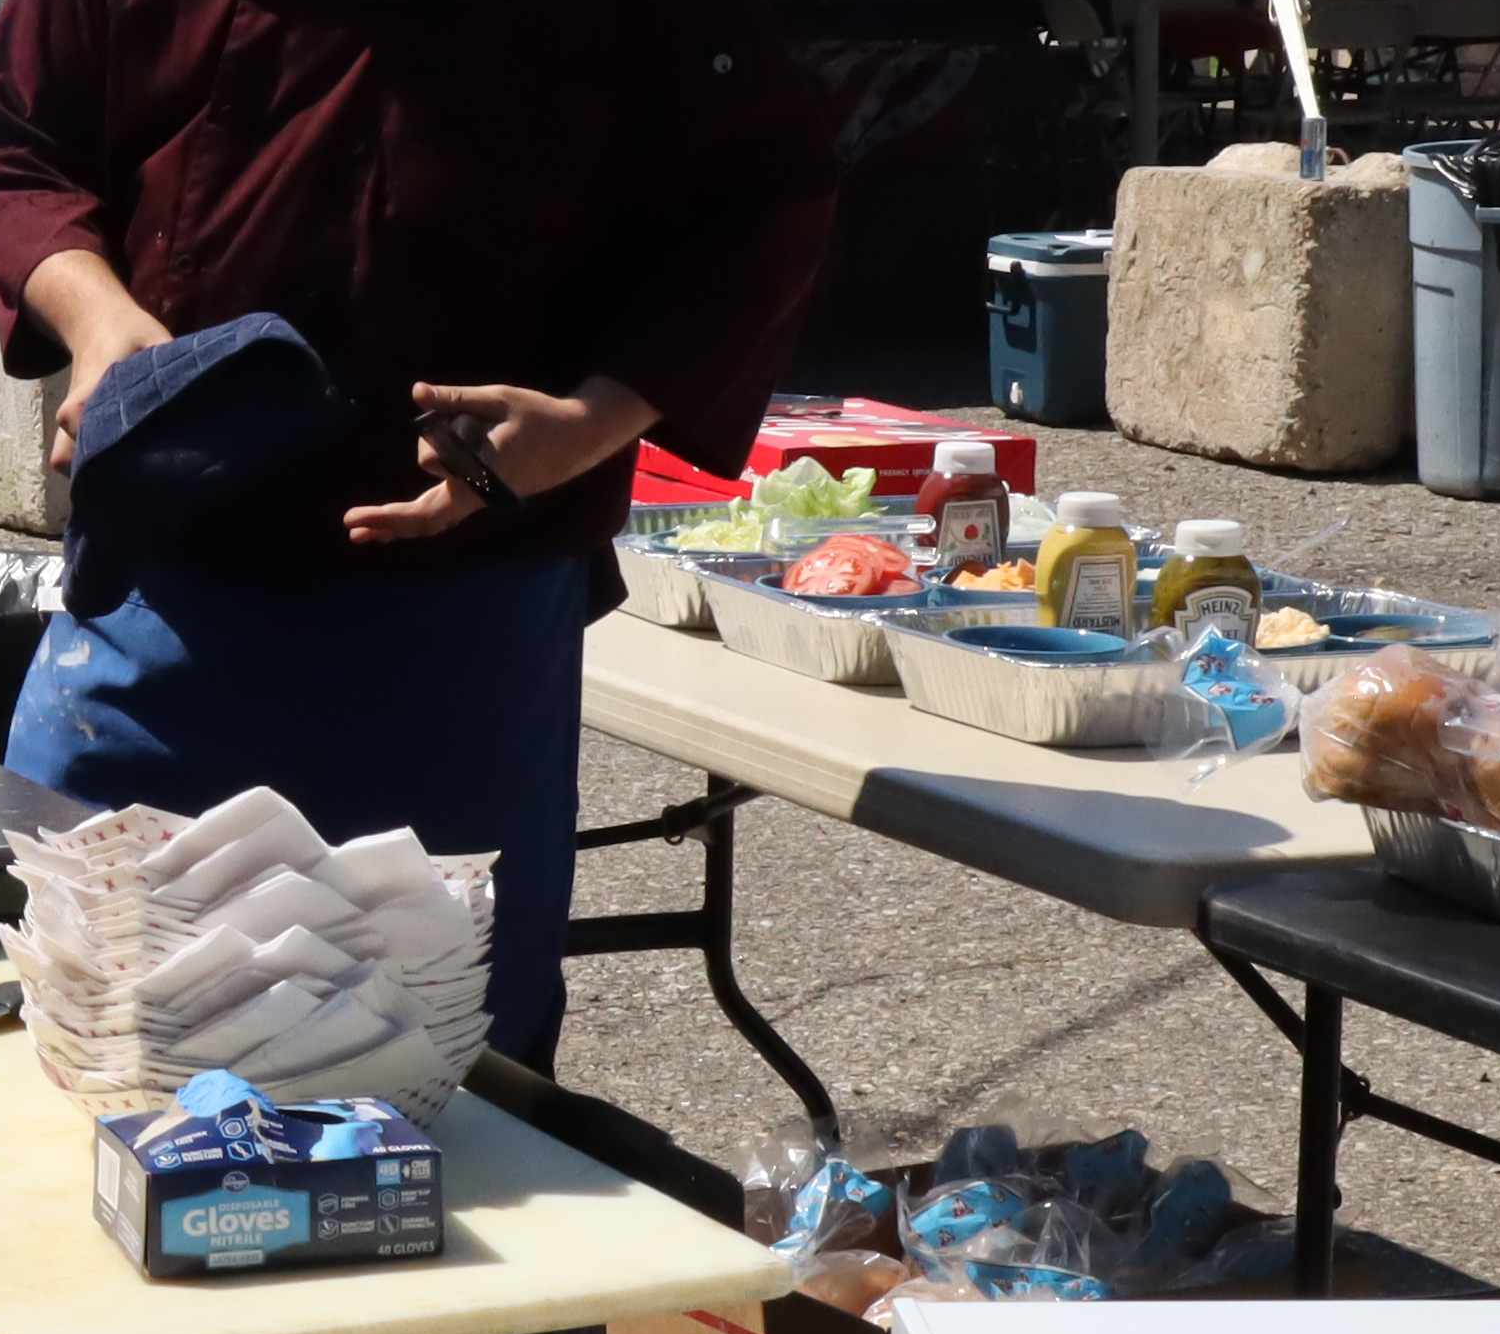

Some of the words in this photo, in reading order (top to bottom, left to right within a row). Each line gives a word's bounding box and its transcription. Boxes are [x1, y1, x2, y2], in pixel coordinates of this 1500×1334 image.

[1200, 600, 1240, 615] HEINZ
[1072, 614, 1121, 628] MUSTARD
[388, 1143, 432, 1153] GLOVES
[378, 1162, 399, 1176] 40
[218, 1199, 280, 1212] DISPOSABLE
[182, 1206, 292, 1237] Gloves
[210, 1233, 263, 1246] NITRILE
[378, 1244, 392, 1255] 40
[393, 1241, 436, 1254] GLOVES
